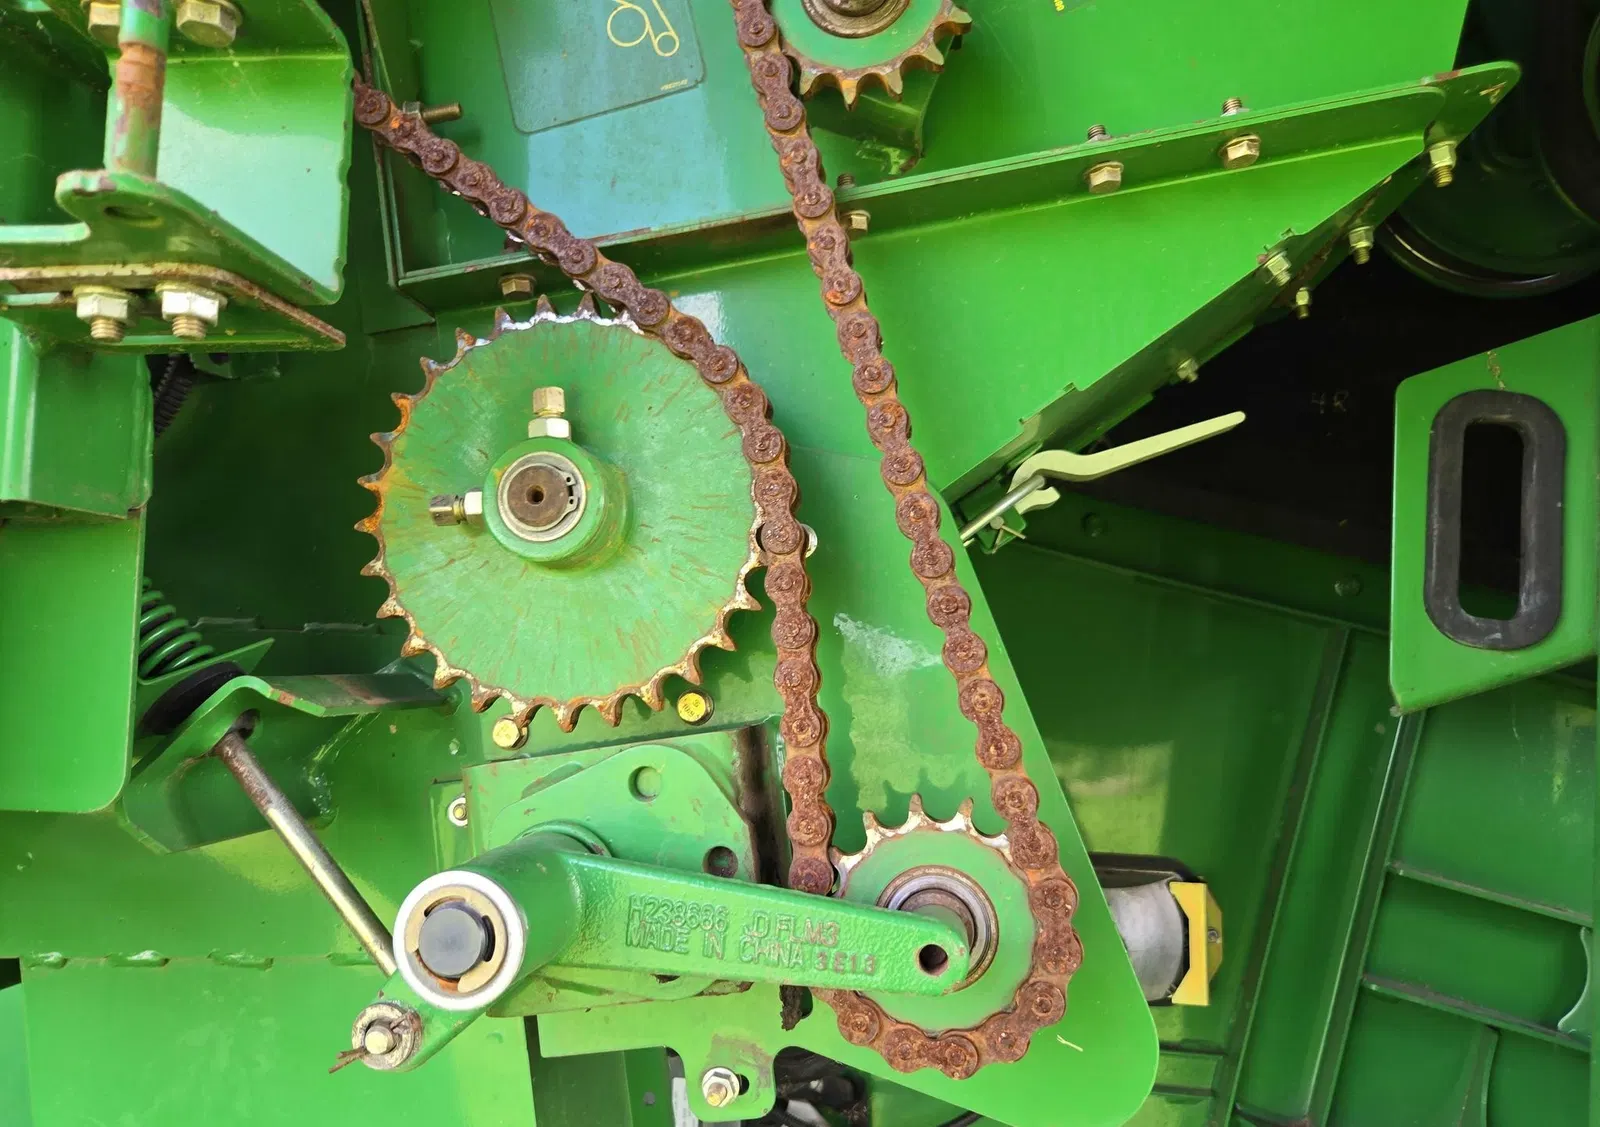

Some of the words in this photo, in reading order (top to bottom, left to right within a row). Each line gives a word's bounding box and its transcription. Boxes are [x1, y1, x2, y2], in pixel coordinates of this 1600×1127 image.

[626, 918, 690, 954] MADE
[702, 930, 726, 960] IN
[740, 935, 803, 968] CHINA
